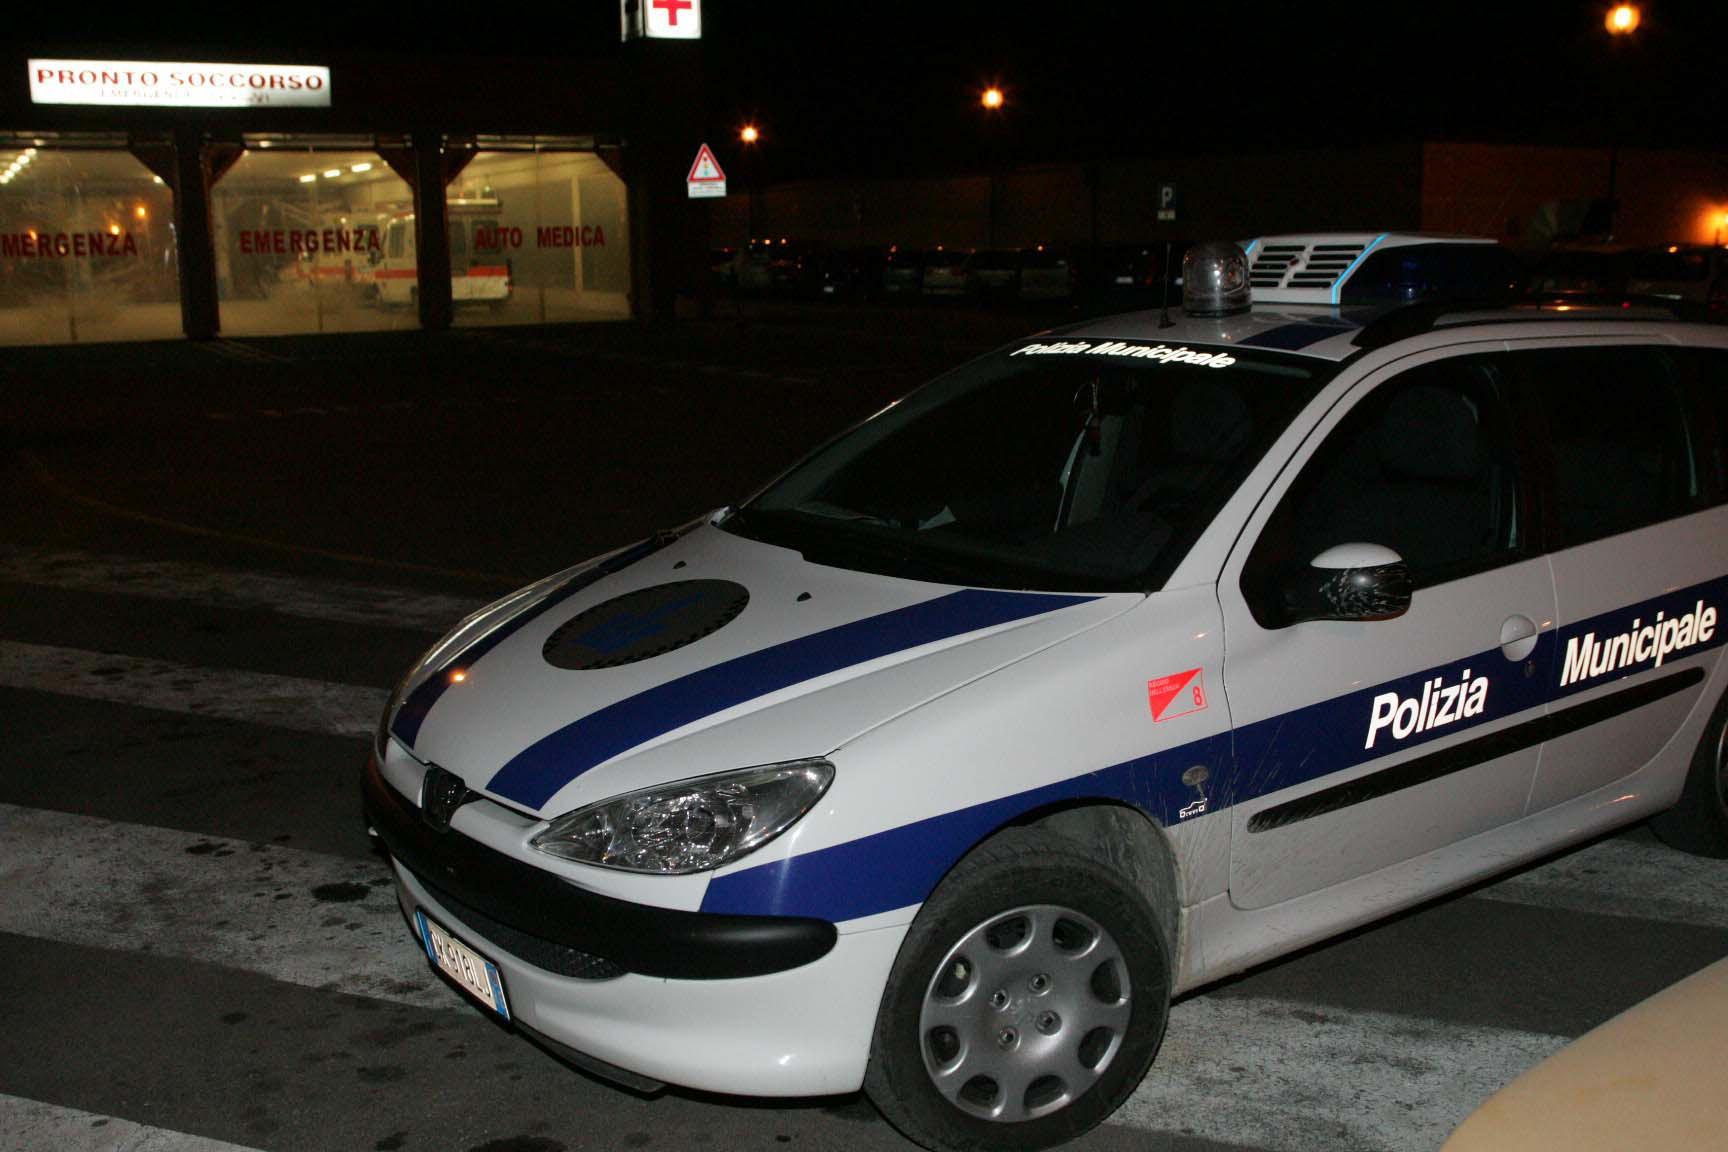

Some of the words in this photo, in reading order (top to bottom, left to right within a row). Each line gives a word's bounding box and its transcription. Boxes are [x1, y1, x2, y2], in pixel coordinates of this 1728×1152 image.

[36, 69, 158, 86] PRONTO
[169, 72, 323, 91] SOCCORSO
[1162, 187, 1173, 209] P
[240, 227, 380, 255] EMERGENZA
[475, 225, 523, 250] AUTO
[536, 224, 605, 249] MEDICA
[1009, 341, 1092, 357] Polizia
[1085, 341, 1236, 369] Municipale
[1364, 668, 1489, 750] Polizia
[1559, 599, 1718, 687] Municipale
[1192, 685, 1203, 706] 8
